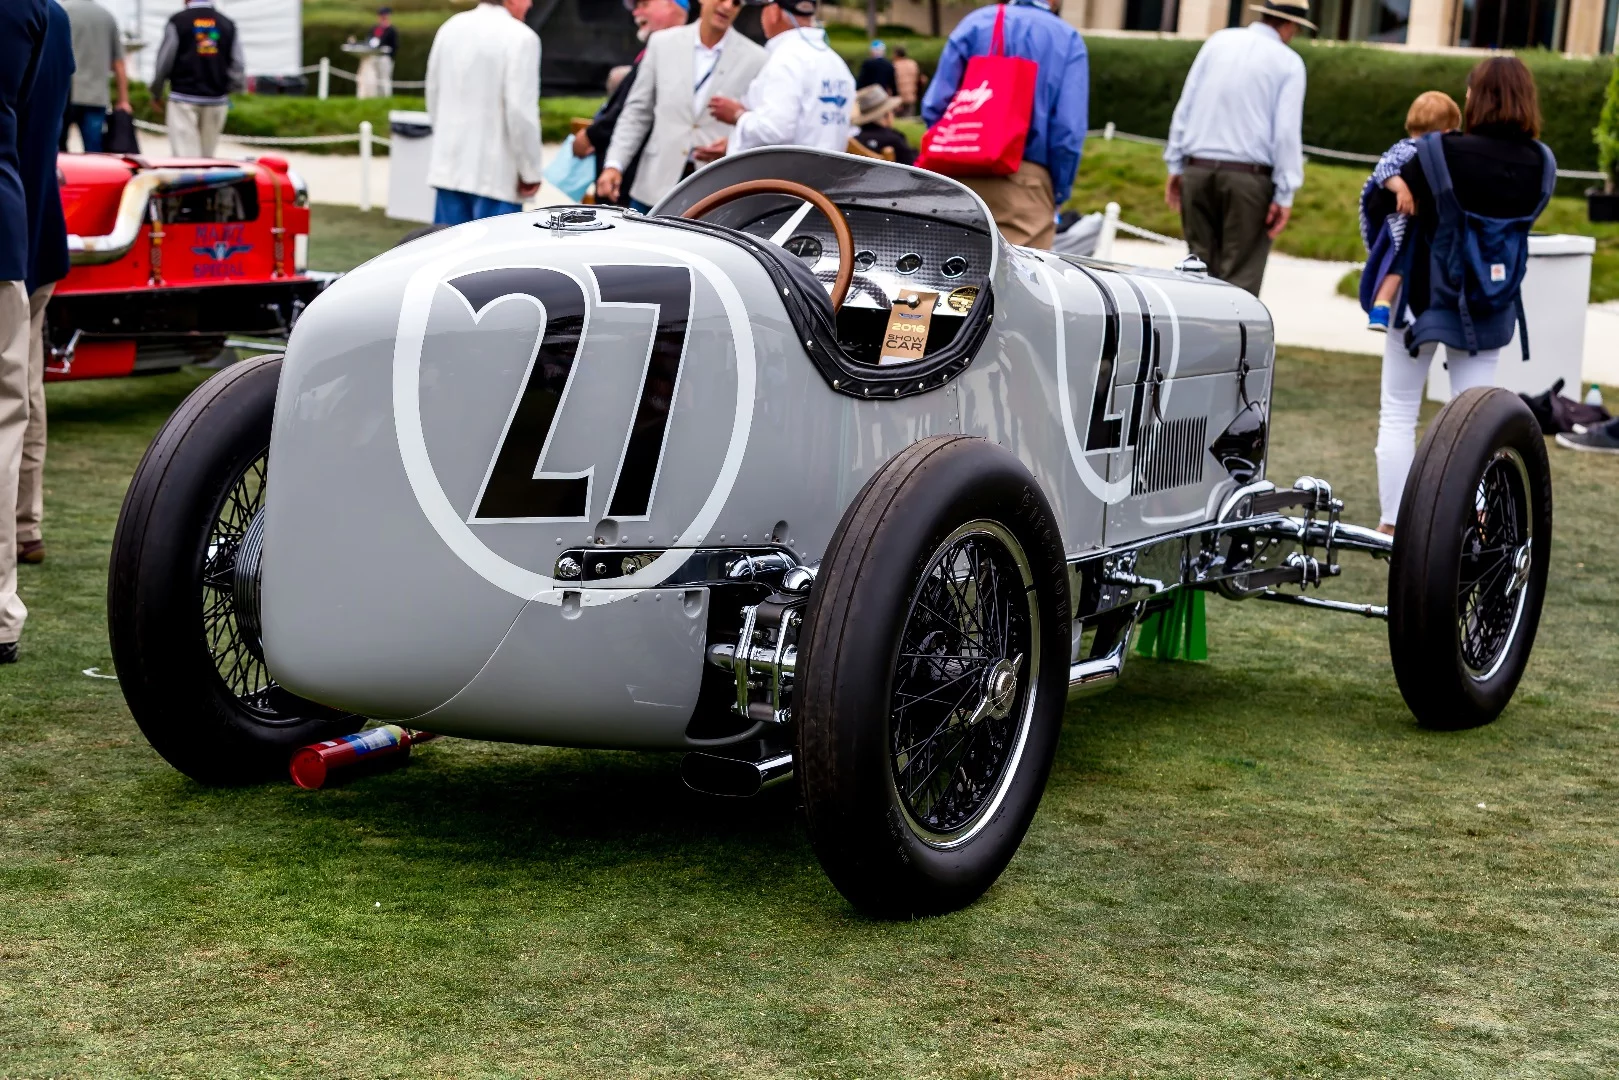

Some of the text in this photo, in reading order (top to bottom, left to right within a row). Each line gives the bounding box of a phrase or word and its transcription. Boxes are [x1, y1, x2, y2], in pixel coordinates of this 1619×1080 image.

[892, 323, 925, 333] 2016
[888, 334, 924, 342] SHOW
[886, 340, 922, 351] CAR
[441, 263, 695, 523] 27
